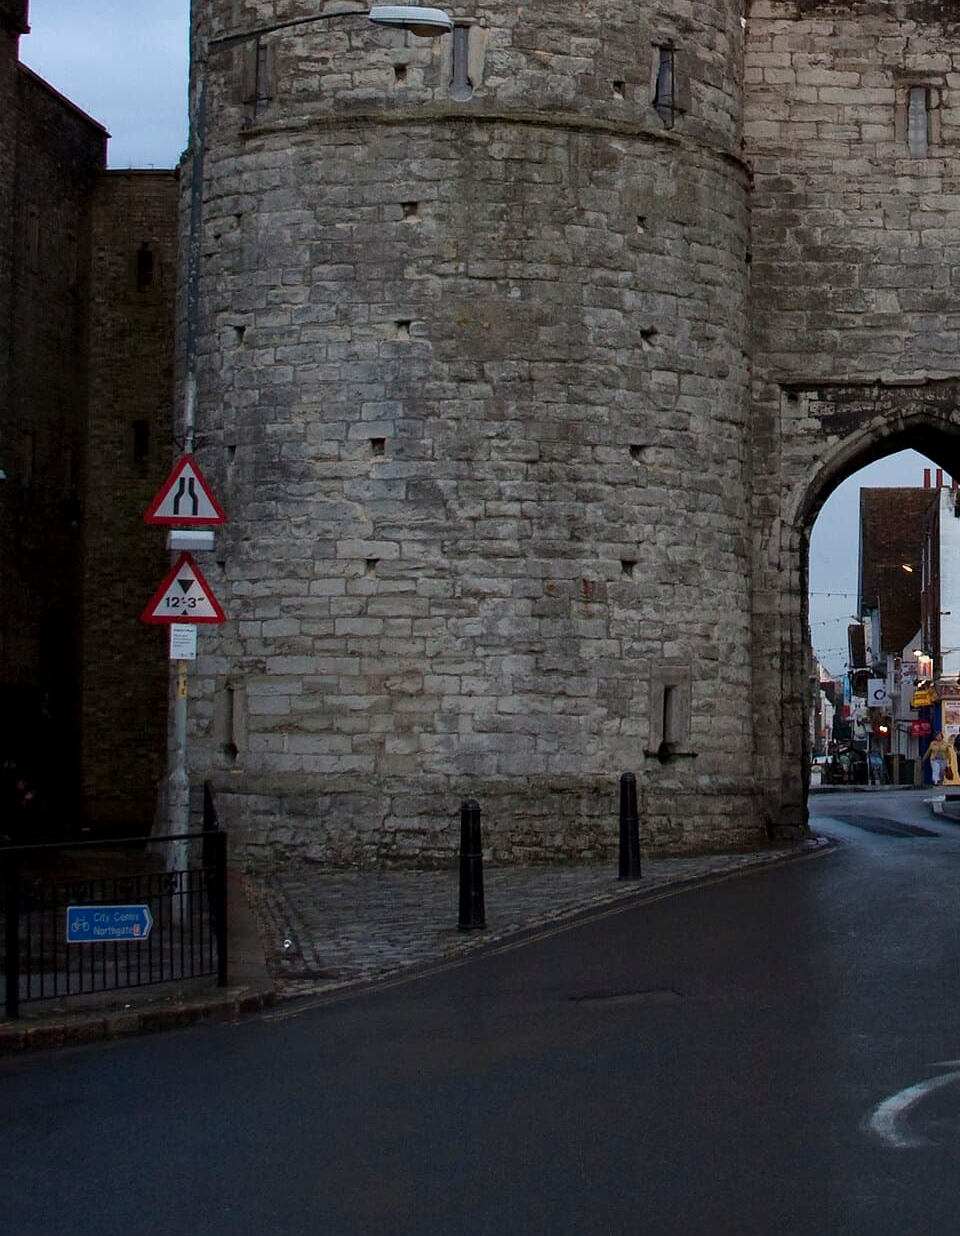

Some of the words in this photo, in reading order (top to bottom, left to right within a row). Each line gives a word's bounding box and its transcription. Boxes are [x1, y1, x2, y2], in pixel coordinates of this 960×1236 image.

[94, 912, 109, 923] City
[113, 911, 140, 922] Centre
[94, 926, 134, 937] Northgate
